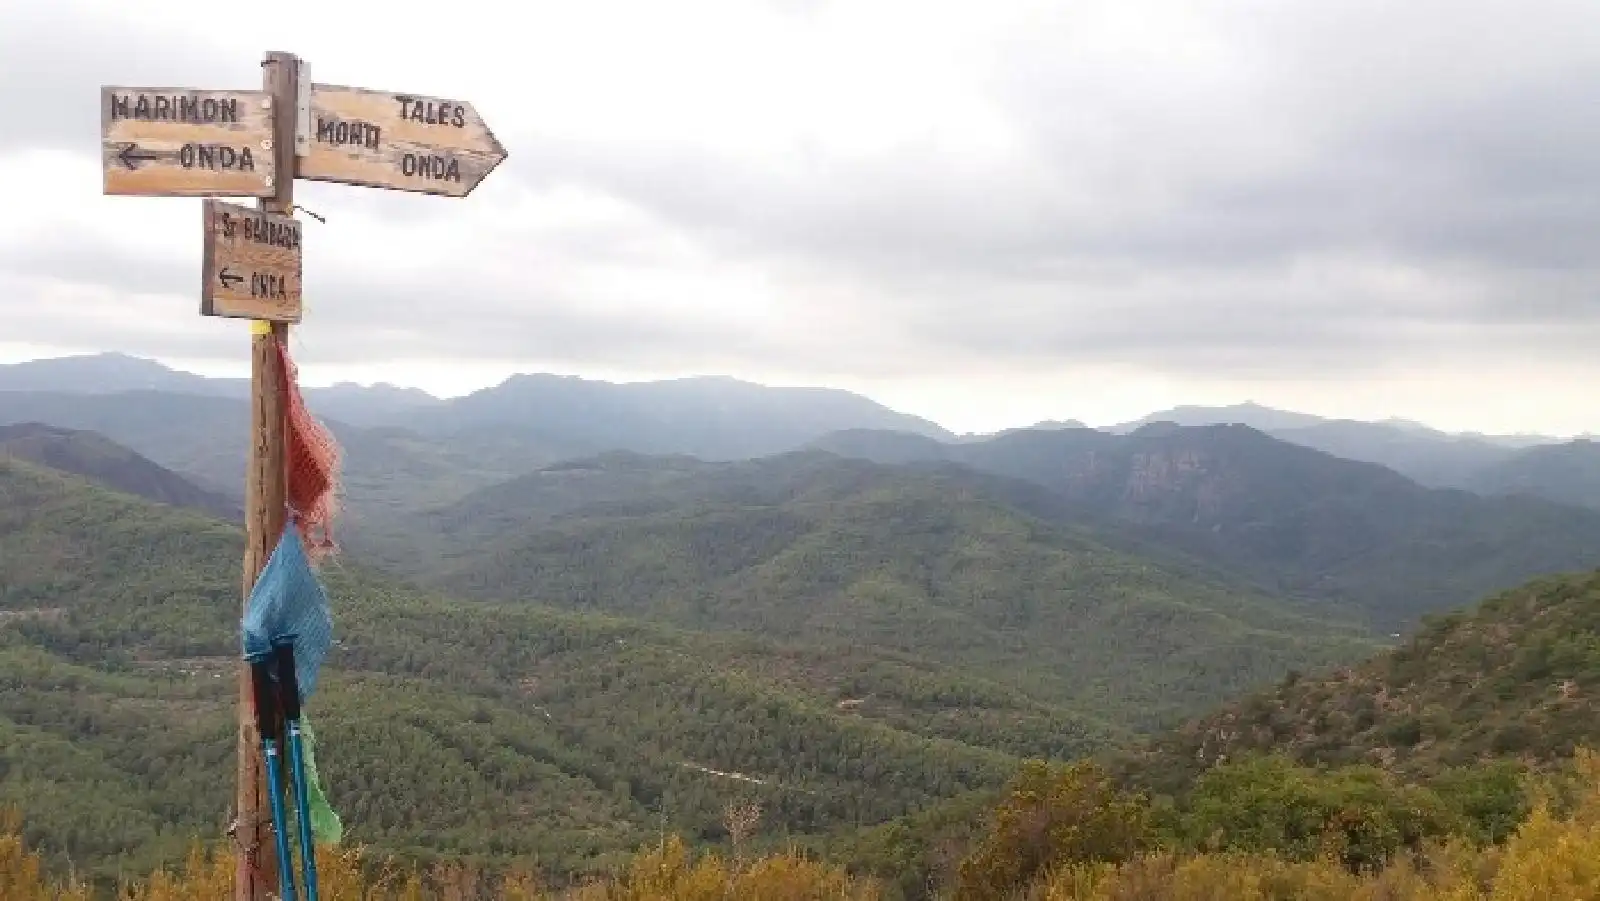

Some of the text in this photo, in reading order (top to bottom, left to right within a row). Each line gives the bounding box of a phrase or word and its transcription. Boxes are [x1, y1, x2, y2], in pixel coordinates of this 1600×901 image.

[111, 94, 237, 122] MARIMON
[396, 95, 465, 128] TALES
[180, 143, 255, 170] ONDA
[402, 153, 461, 183] ONDA
